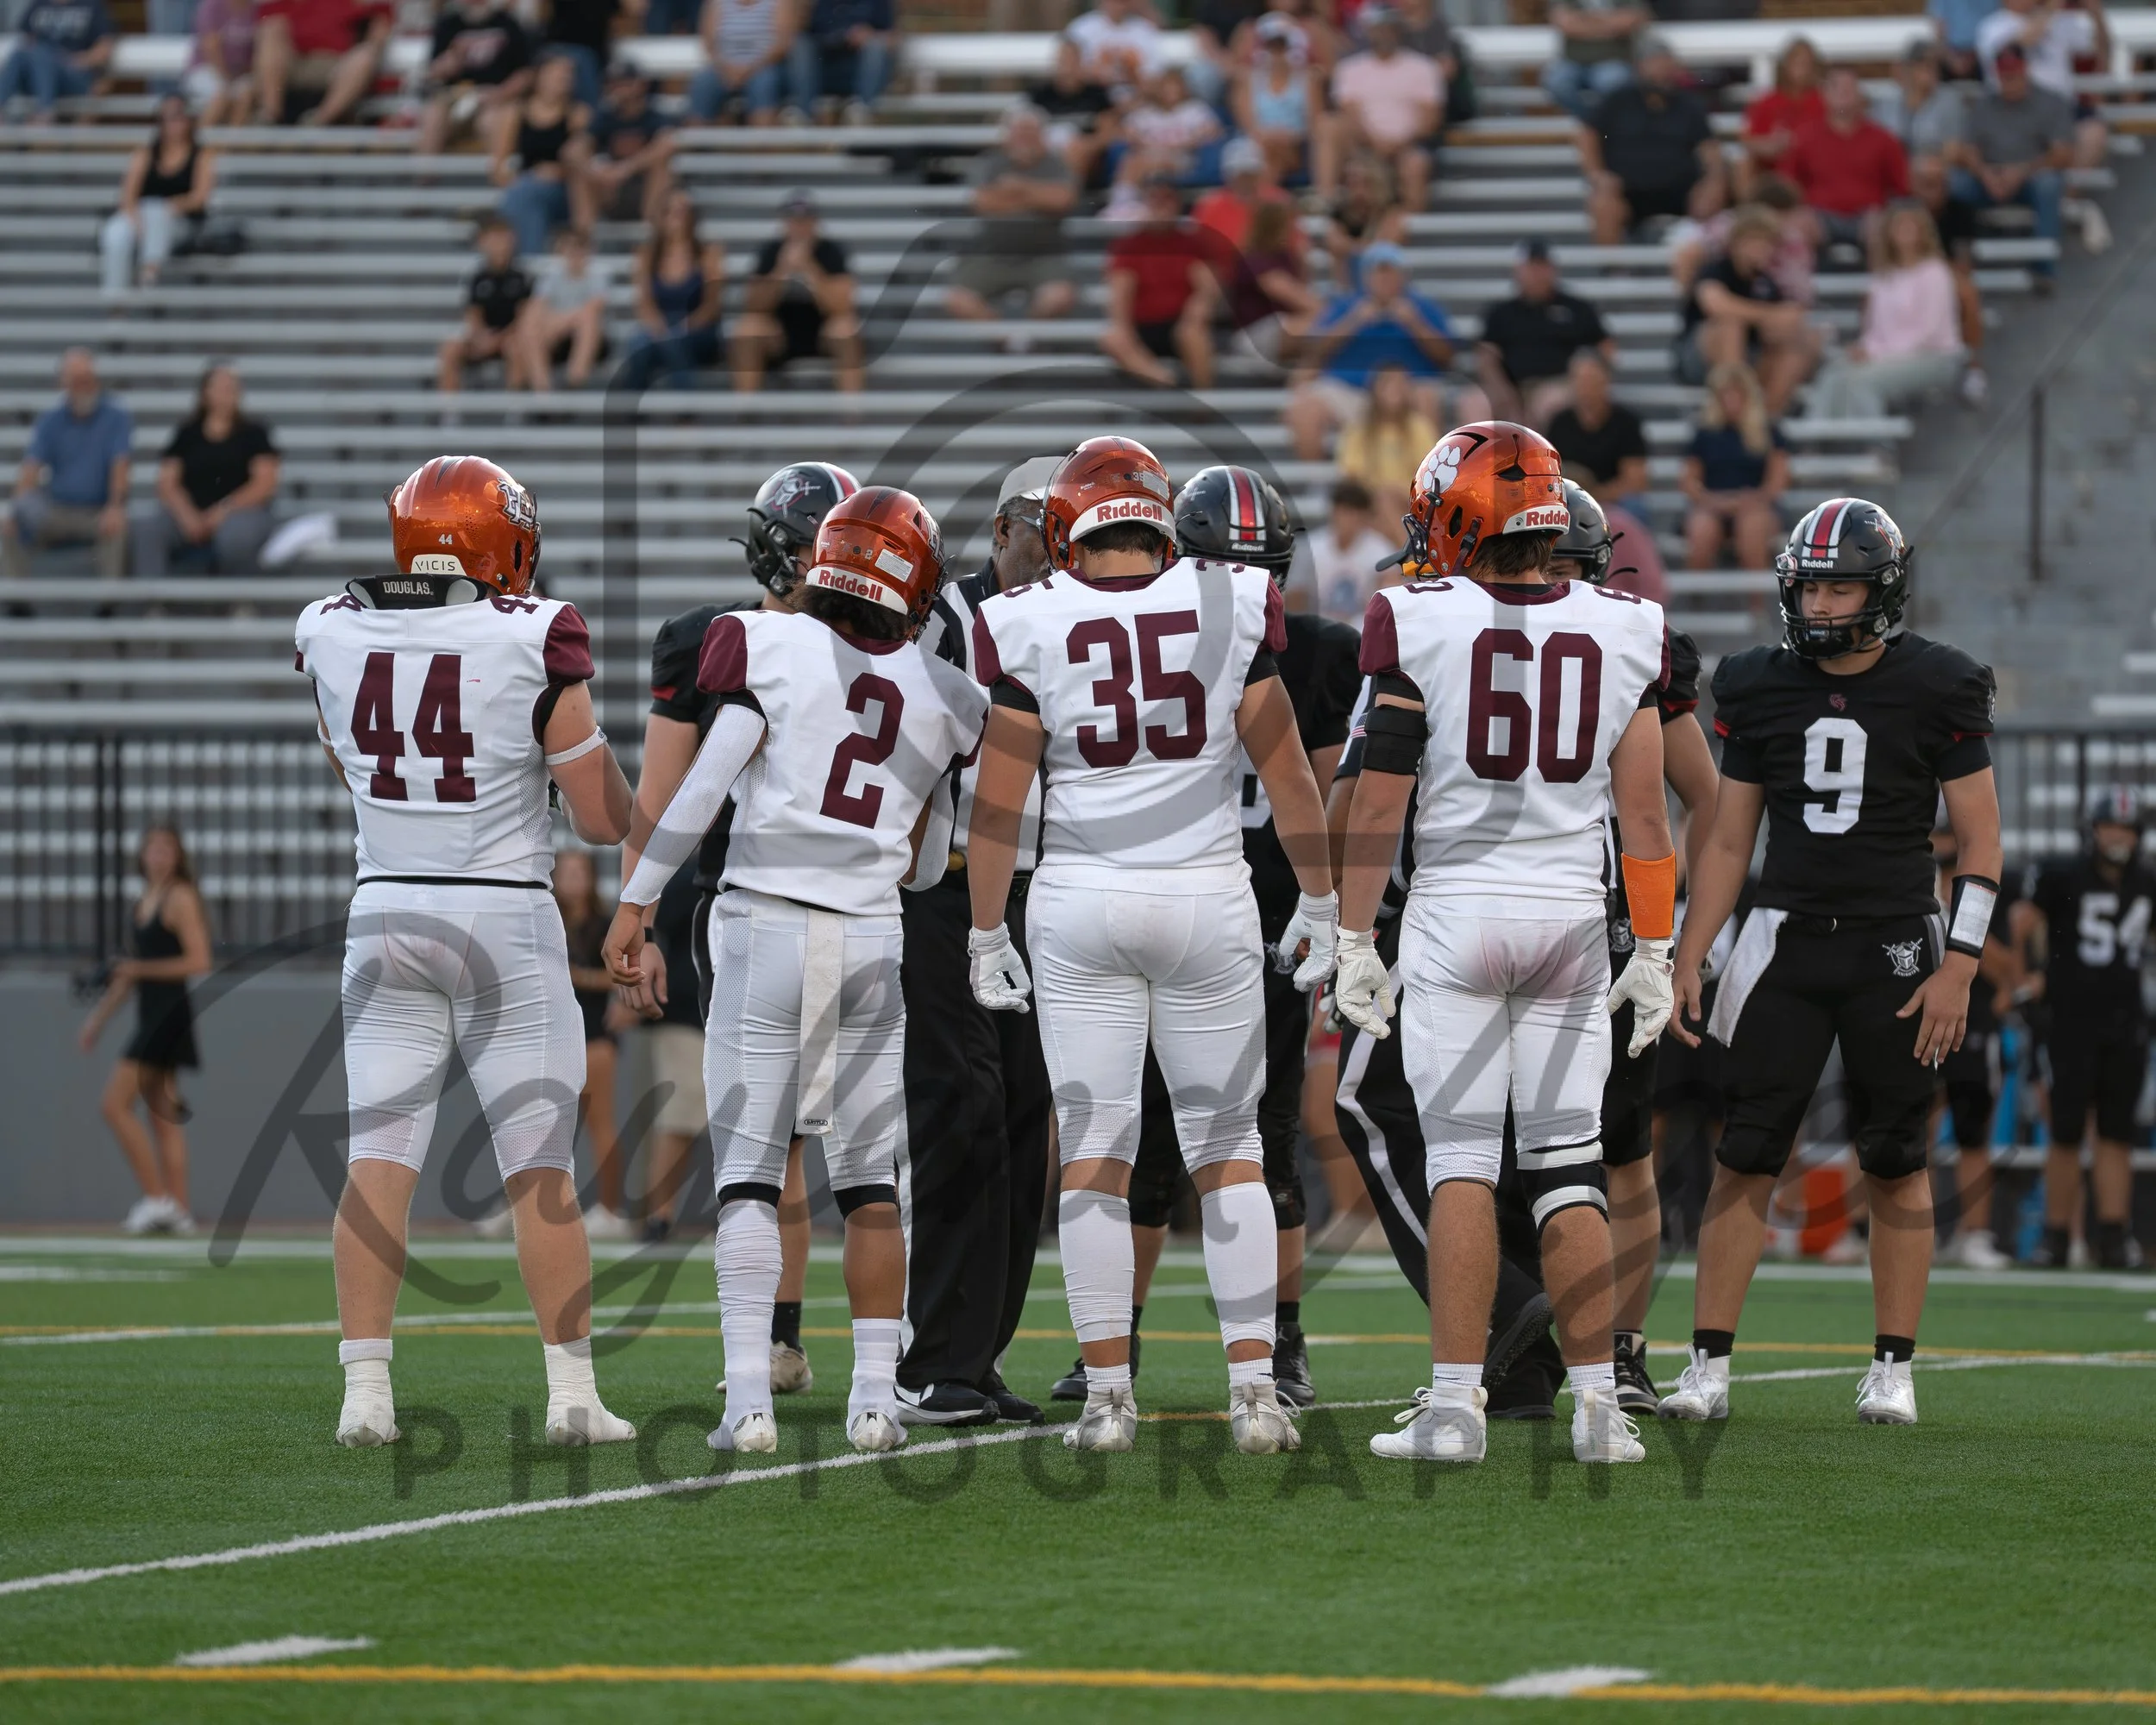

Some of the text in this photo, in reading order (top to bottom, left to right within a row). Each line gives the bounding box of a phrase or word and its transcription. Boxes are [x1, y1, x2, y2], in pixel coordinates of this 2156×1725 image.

[1096, 502, 1163, 523] Riddell
[1526, 511, 1569, 528] Riddel
[438, 534, 453, 545] 44
[415, 560, 455, 571] VICIS
[1802, 559, 1833, 568] Riddell
[382, 581, 430, 595] DOUGLAS
[818, 569, 884, 602] Riddell
[1066, 609, 1207, 768] 35
[1466, 628, 1603, 784] 60
[350, 651, 477, 803] 44
[819, 672, 905, 828] 2
[1802, 717, 1868, 835] 9
[2077, 892, 2152, 968] 54
